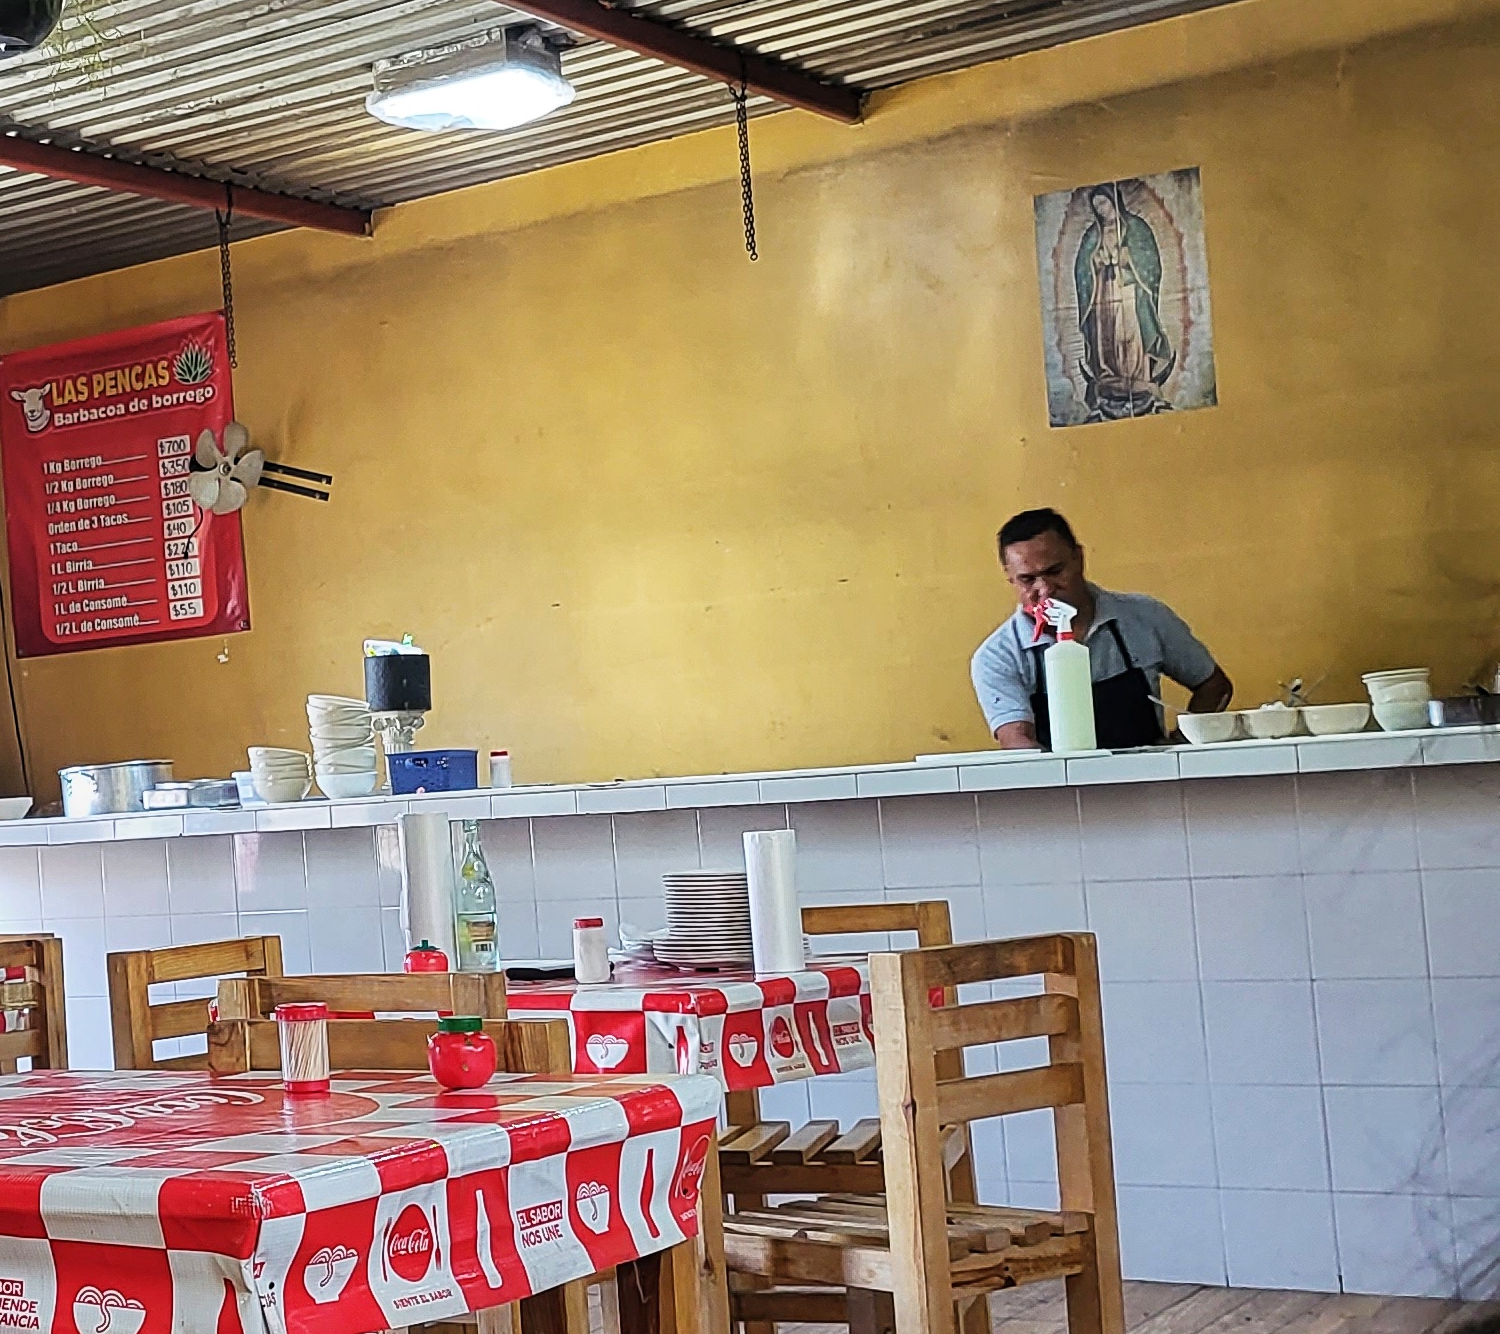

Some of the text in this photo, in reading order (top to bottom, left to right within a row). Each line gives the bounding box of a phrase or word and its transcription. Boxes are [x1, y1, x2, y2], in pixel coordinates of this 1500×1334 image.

[52, 361, 170, 405] LAS PENCAS
[54, 385, 214, 427] Barbacoa de borrego
[49, 462, 62, 474] Kg
[64, 456, 102, 472] Borrego
[159, 439, 186, 455] $700
[45, 481, 59, 495] 1/2
[61, 480, 74, 493] Kg
[76, 474, 114, 491] Borrego
[47, 480, 188, 515] 1/4 Kg Borrego $180
[48, 500, 189, 535] Orden de 3 Tacos $105
[56, 541, 78, 554] Taco
[166, 522, 186, 536] $40
[53, 582, 67, 595] 1/2
[77, 578, 104, 592] Birria
[169, 561, 193, 577] $110
[66, 559, 92, 573] Birria
[69, 601, 81, 613] de
[82, 595, 127, 612] Consomé
[171, 581, 196, 597] $110
[56, 623, 71, 636] 1/2
[81, 620, 93, 633] de
[94, 613, 140, 630] Consomé
[172, 602, 196, 617] $55
[519, 1204, 562, 1228] EL SABOR
[521, 1224, 563, 1248] NOS UNE
